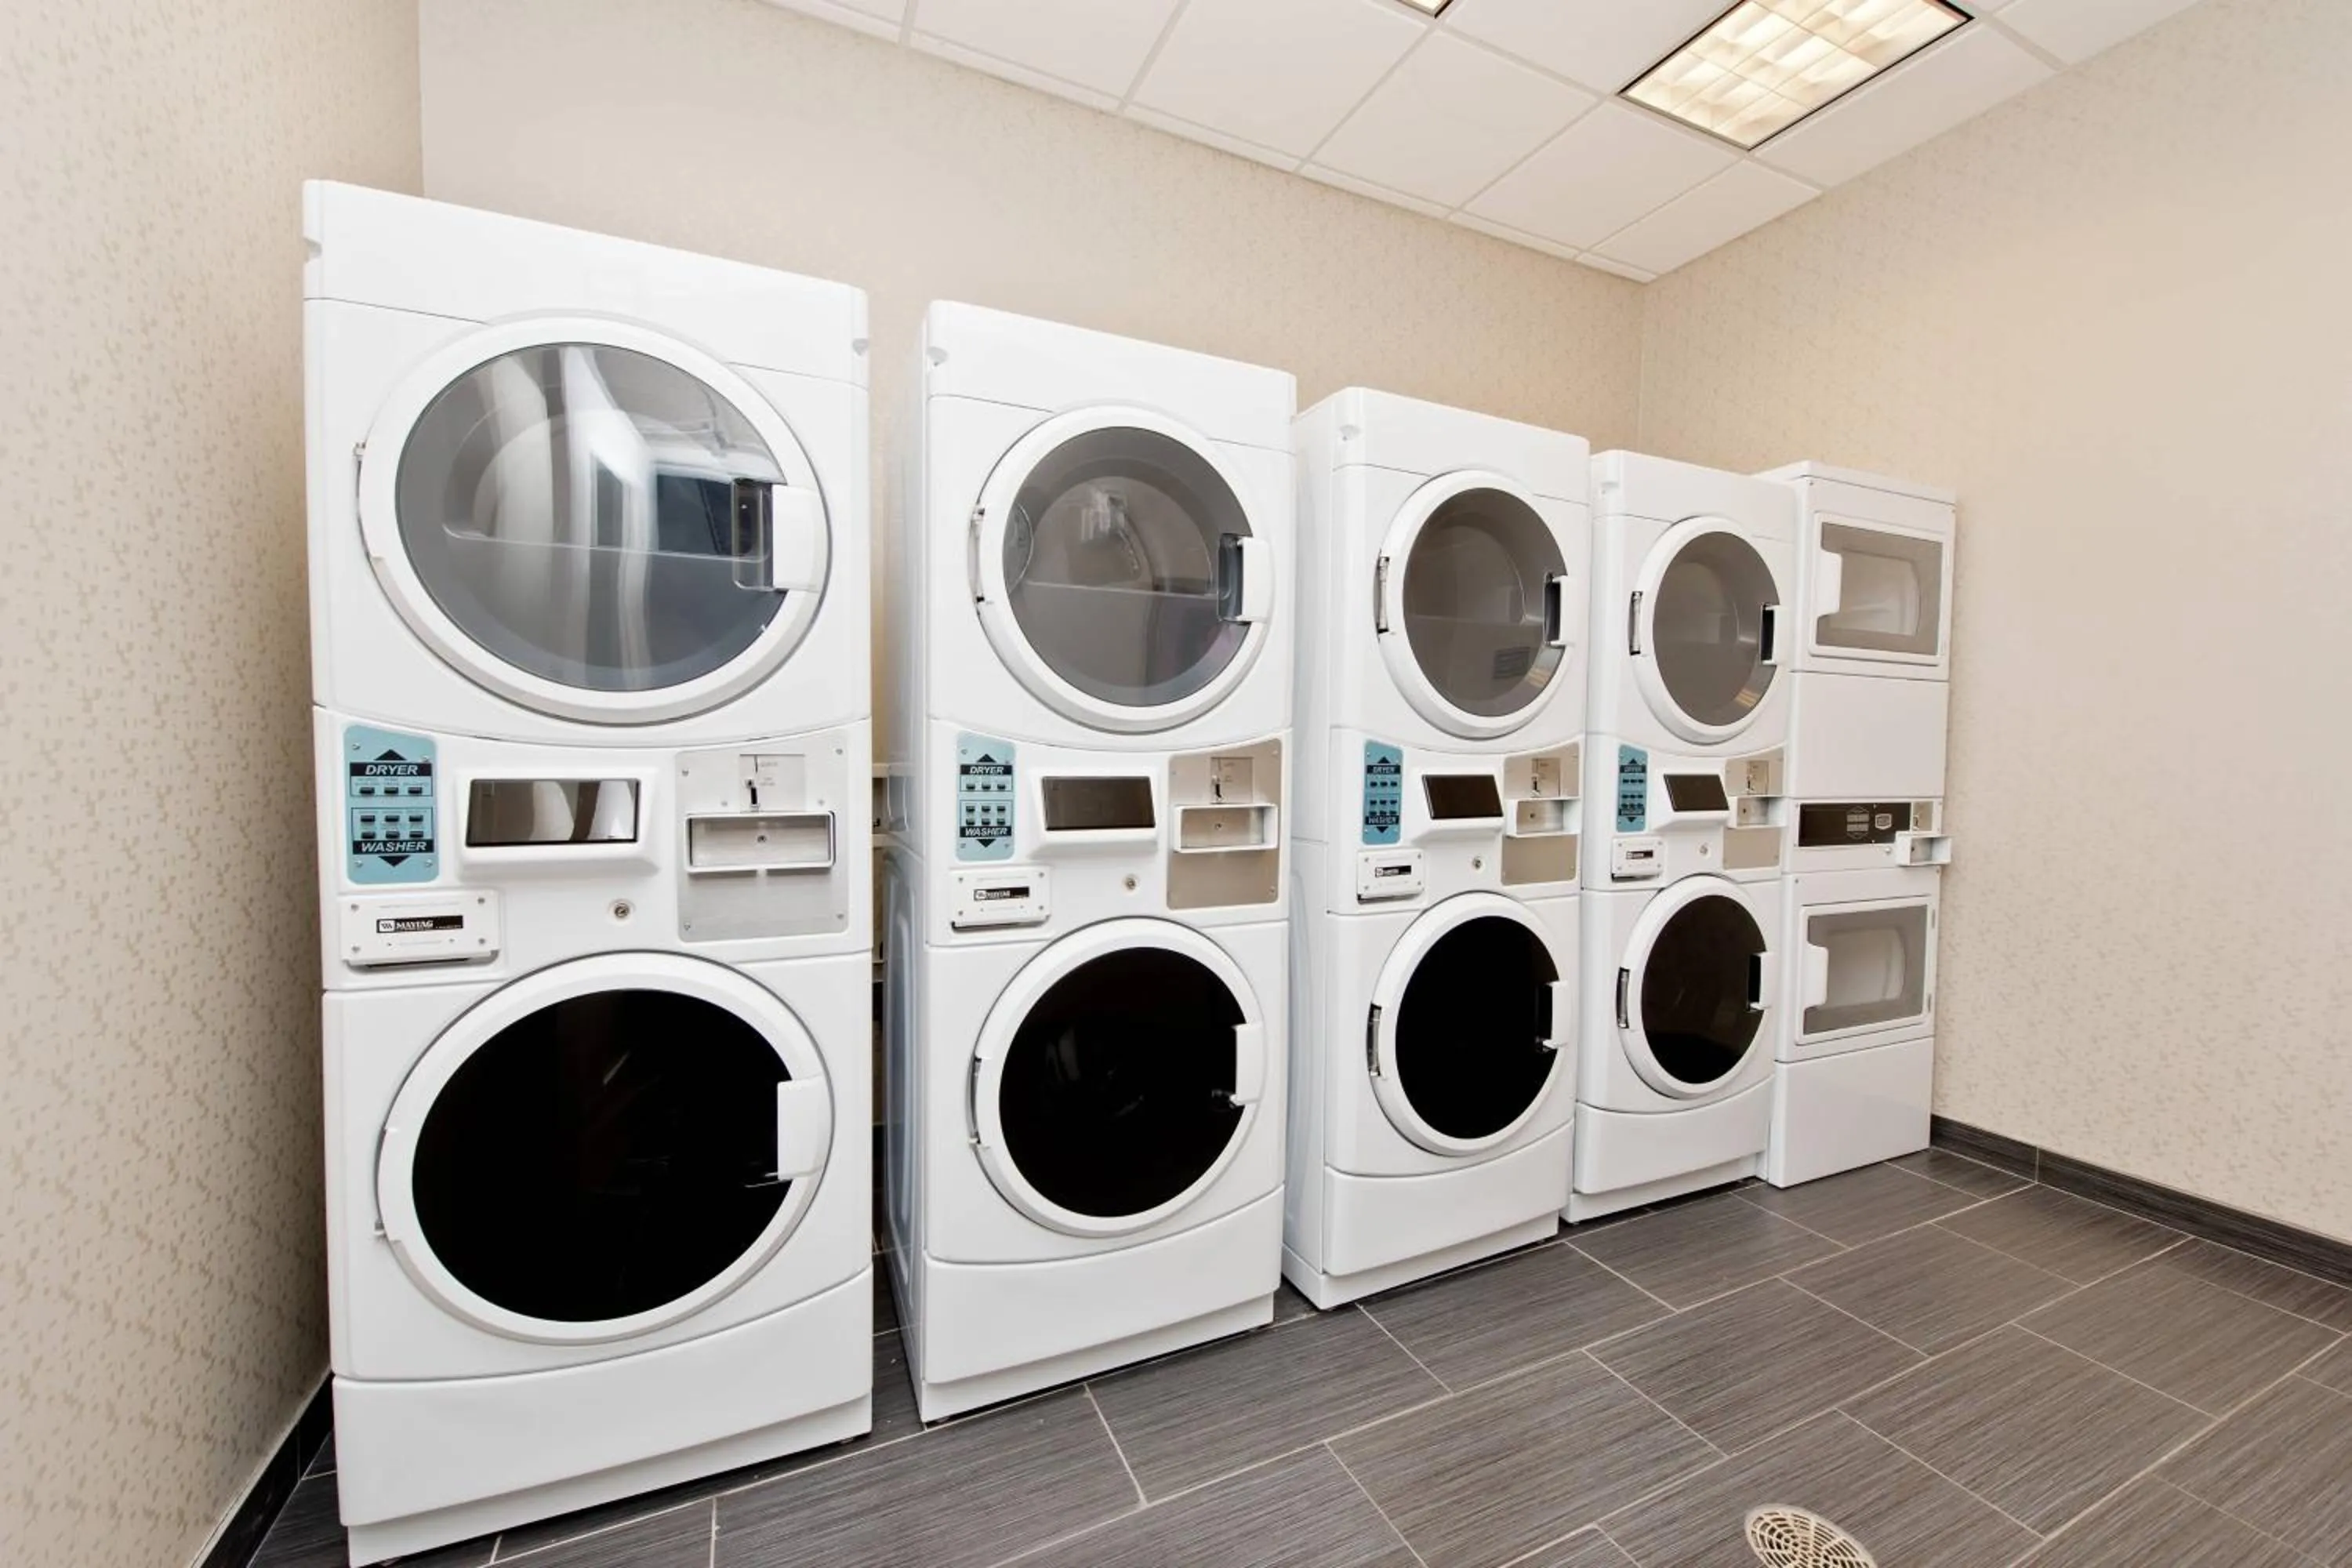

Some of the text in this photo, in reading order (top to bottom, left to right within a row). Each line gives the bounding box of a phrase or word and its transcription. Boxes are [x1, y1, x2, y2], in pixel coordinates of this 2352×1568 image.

[365, 764, 419, 775] DRYER
[965, 827, 1007, 837] WASHER
[361, 841, 427, 852] WASHER
[396, 920, 434, 930] MAYTAG
